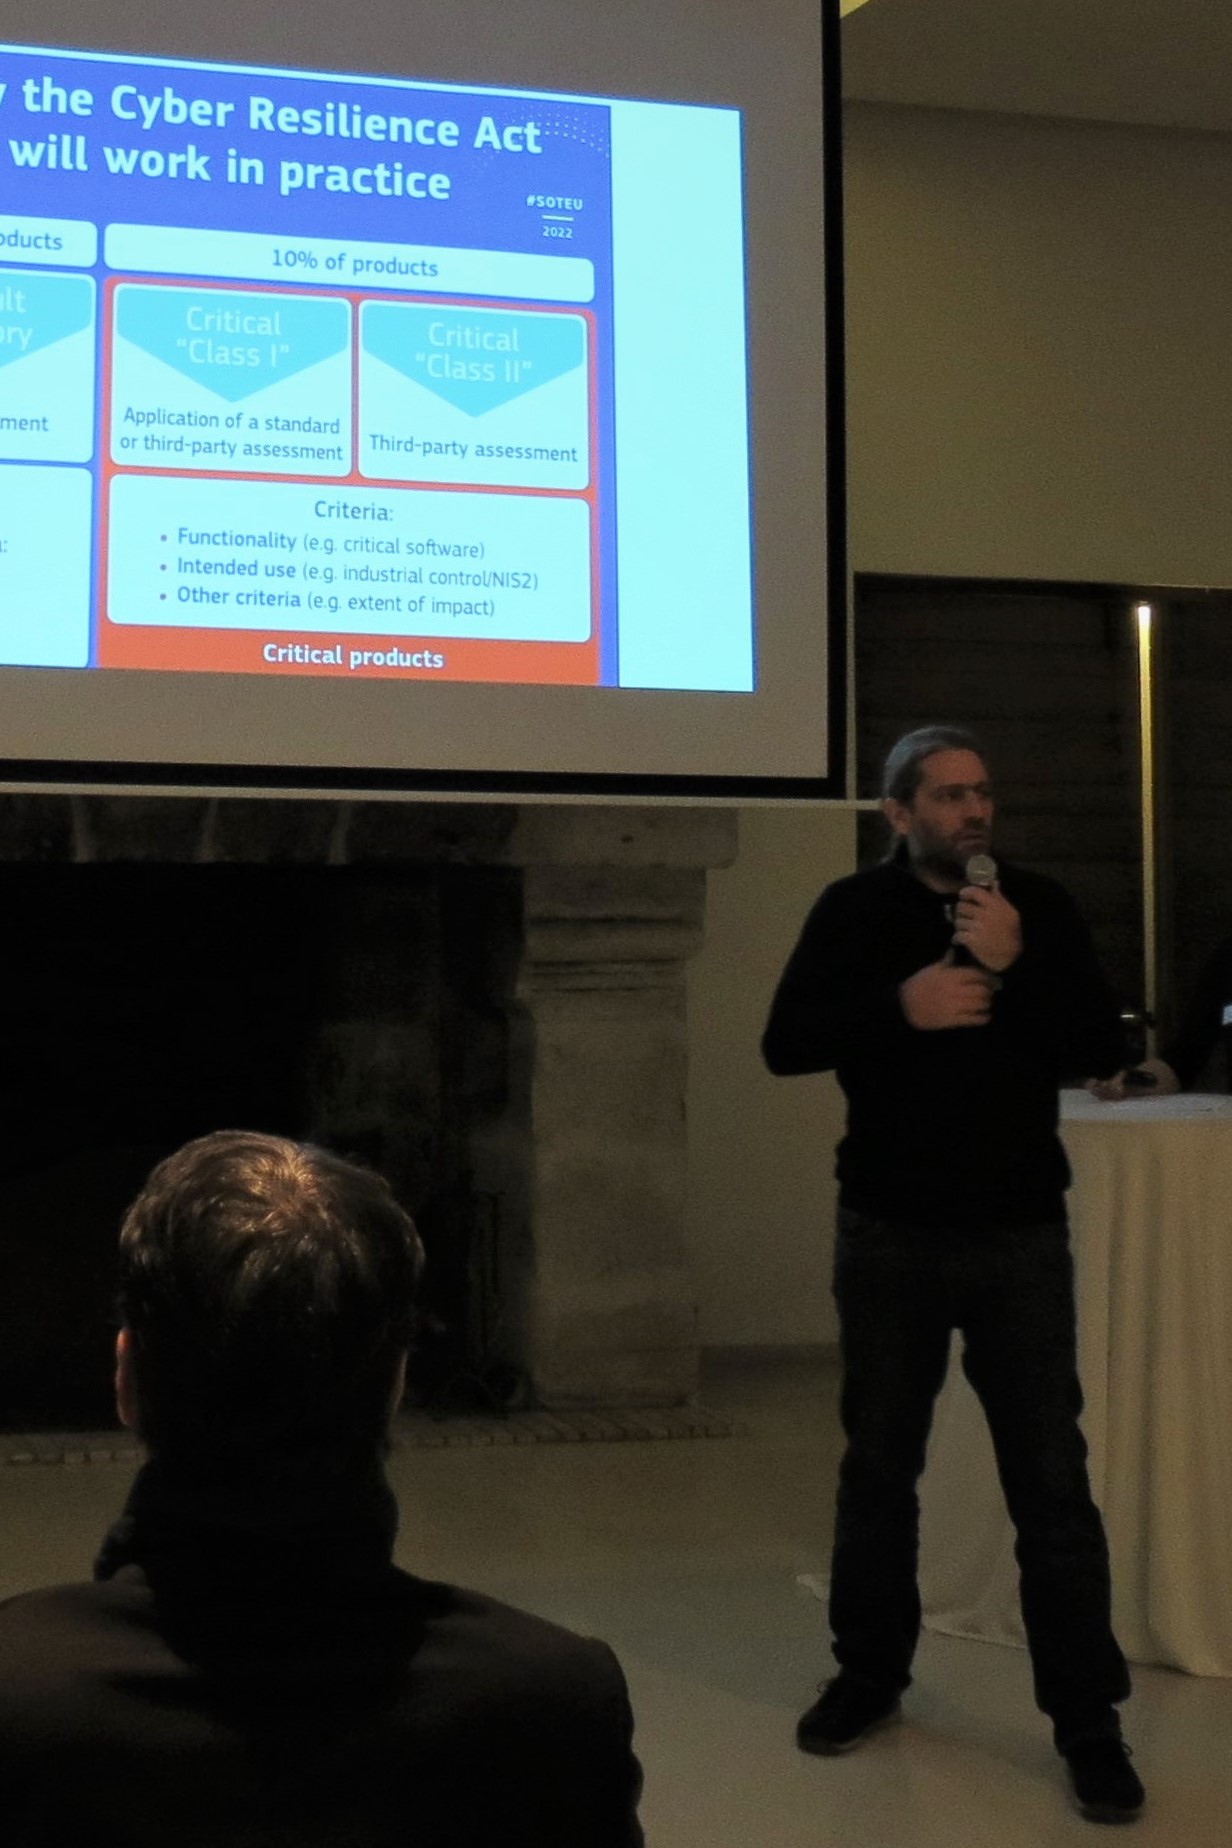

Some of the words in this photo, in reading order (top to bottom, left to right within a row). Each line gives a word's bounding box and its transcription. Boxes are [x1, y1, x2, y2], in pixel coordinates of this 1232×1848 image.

[23, 77, 93, 115] the
[112, 85, 234, 129] Cyber
[250, 97, 459, 146] Resilience
[474, 117, 541, 153] Act
[9, 134, 87, 170] will
[103, 145, 210, 180] work
[228, 148, 263, 184] in
[281, 161, 450, 199] practice
[527, 195, 582, 210] #SOTEU
[543, 226, 572, 238] 2022
[273, 249, 317, 268] 10%
[326, 253, 346, 270] of
[353, 257, 438, 277] products
[187, 306, 281, 335] Critical
[428, 322, 519, 351] Critical
[124, 407, 219, 427] Application
[225, 413, 243, 428] of
[249, 418, 258, 429] a
[265, 416, 340, 434] standard
[121, 437, 138, 448] or
[144, 434, 237, 458] third-party
[243, 444, 342, 460] assessment
[370, 434, 468, 458] Third-party
[475, 445, 577, 462] assessment
[315, 501, 392, 521] Criteria:
[179, 527, 296, 552] Functionality
[304, 534, 338, 555] (e.g.
[344, 538, 400, 554] critical
[406, 539, 484, 558] software)
[178, 557, 258, 576] Intended
[265, 566, 296, 578] use
[303, 564, 337, 583] (e.g.
[344, 565, 422, 583] industrial
[429, 571, 538, 590] control/NIS2)
[178, 586, 229, 603] Other
[236, 591, 301, 607] criteria
[308, 592, 342, 613] (e.g.
[348, 596, 401, 611] extent
[408, 596, 425, 612] of
[432, 600, 494, 617] impact)
[264, 644, 343, 664] Critical
[350, 648, 442, 669] products
